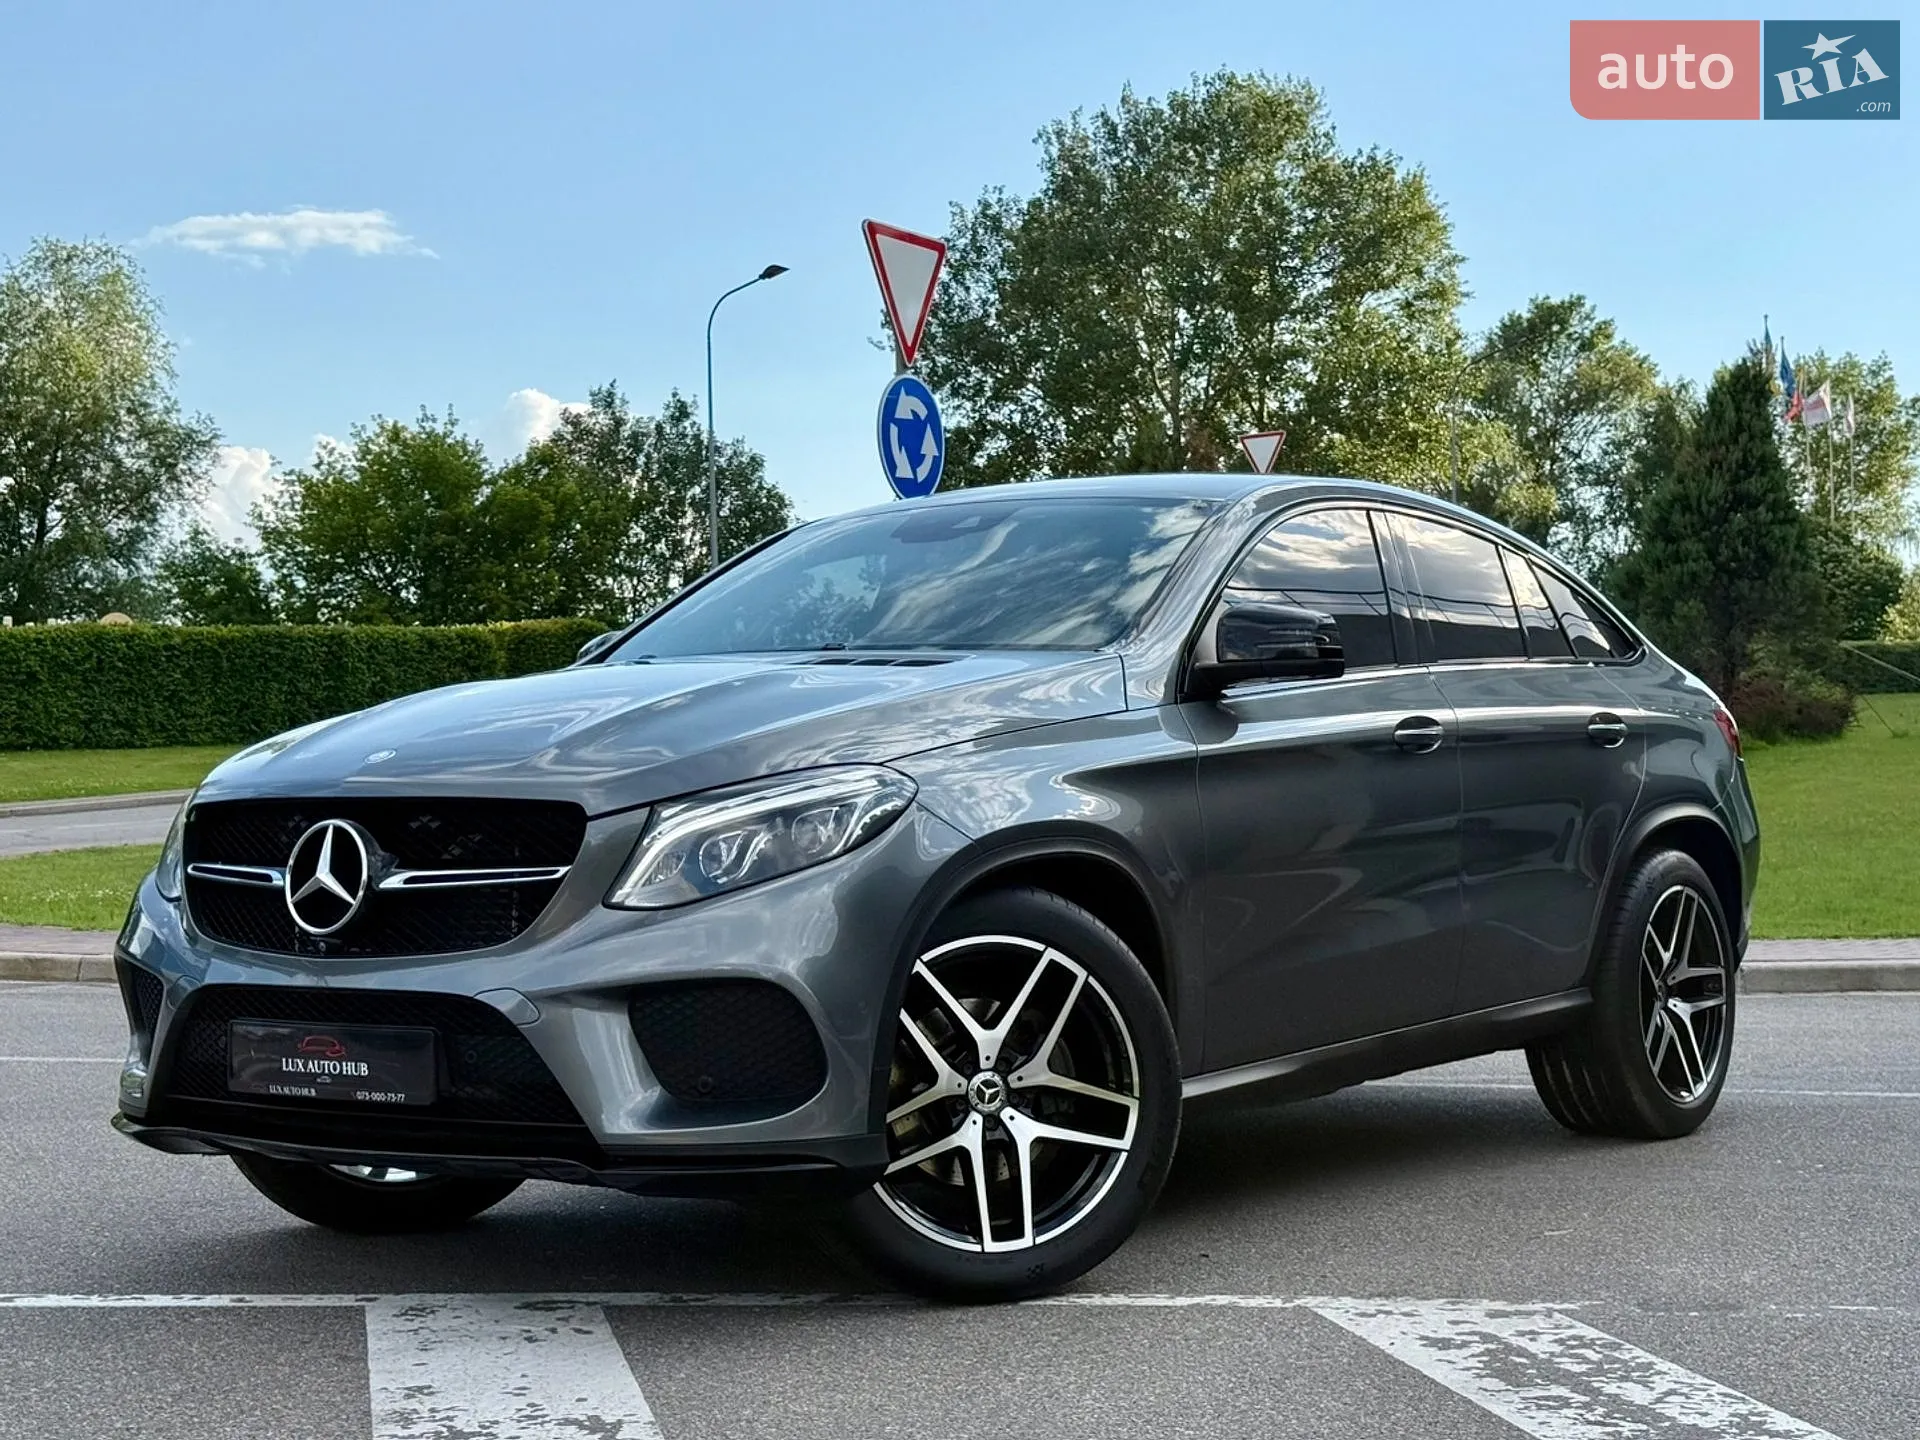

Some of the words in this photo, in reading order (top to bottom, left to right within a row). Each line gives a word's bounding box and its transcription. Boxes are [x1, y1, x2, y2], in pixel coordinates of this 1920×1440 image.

[282, 1058, 304, 1072] LUX
[307, 1060, 340, 1074] AUTO
[342, 1061, 368, 1076] HUB
